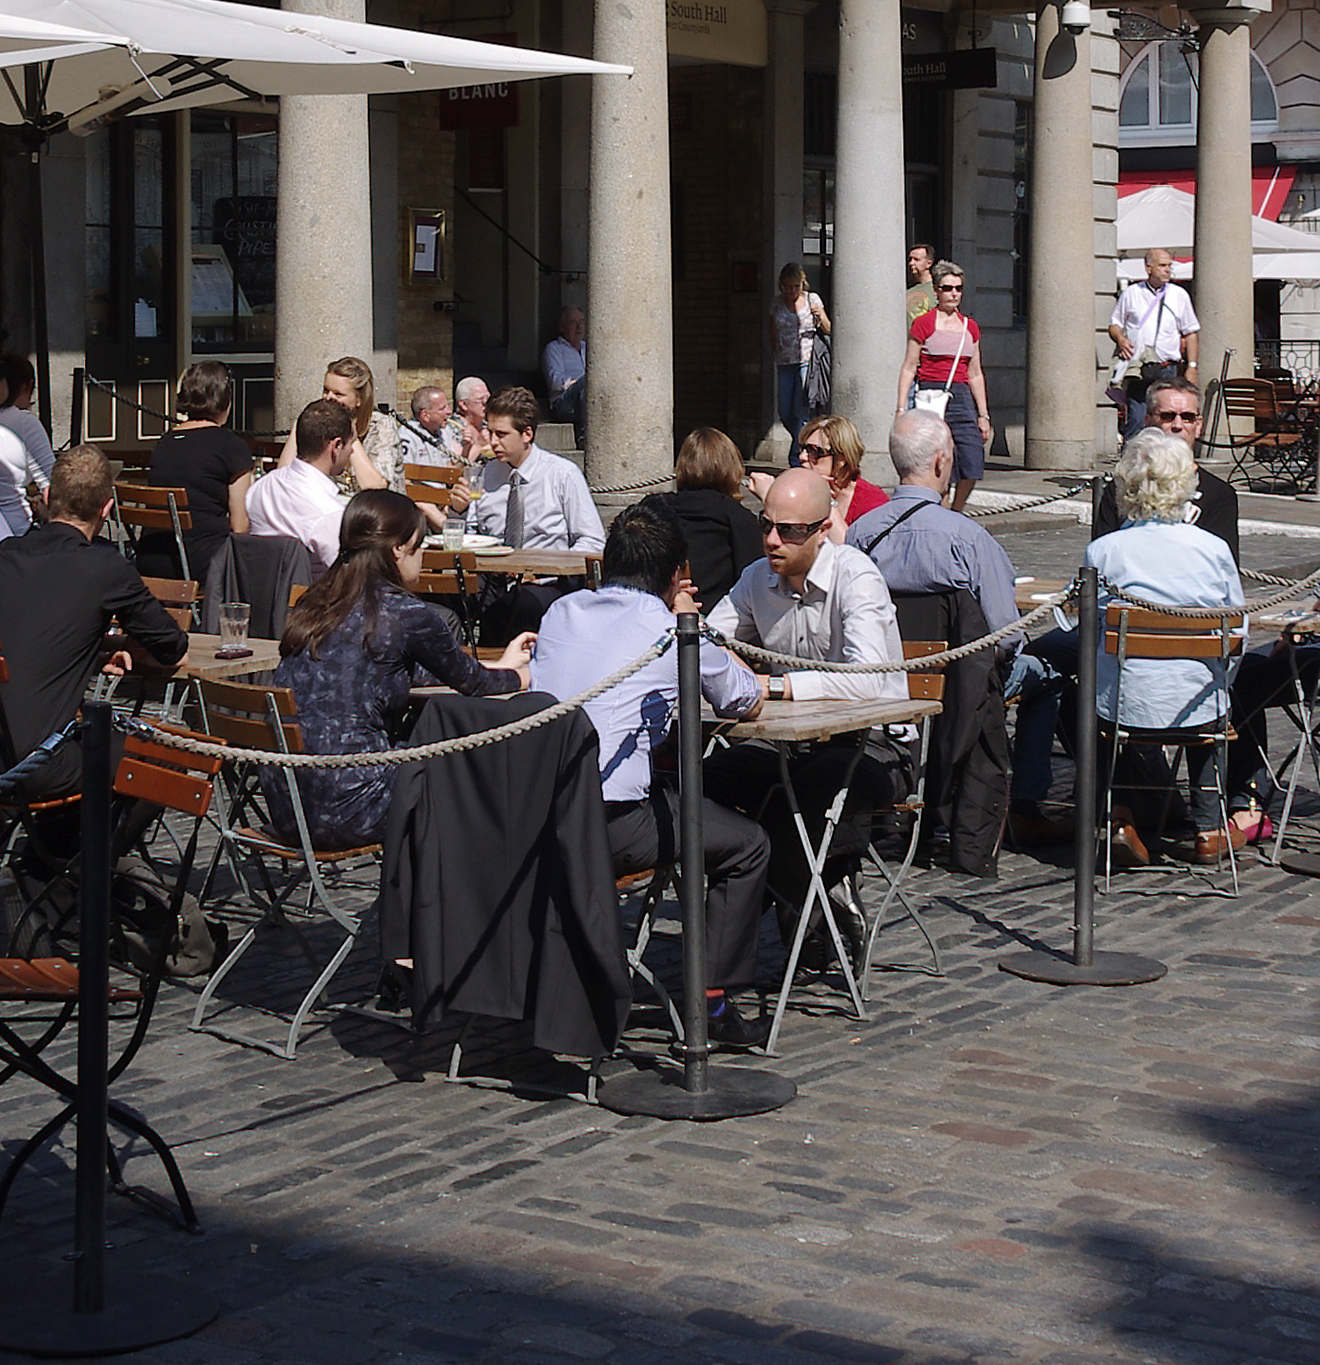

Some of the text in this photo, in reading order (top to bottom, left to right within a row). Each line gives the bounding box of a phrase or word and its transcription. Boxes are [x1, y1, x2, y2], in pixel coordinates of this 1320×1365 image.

[671, 0, 727, 24] South Hall
[926, 62, 946, 74] Hall
[448, 82, 509, 101] BLANC
